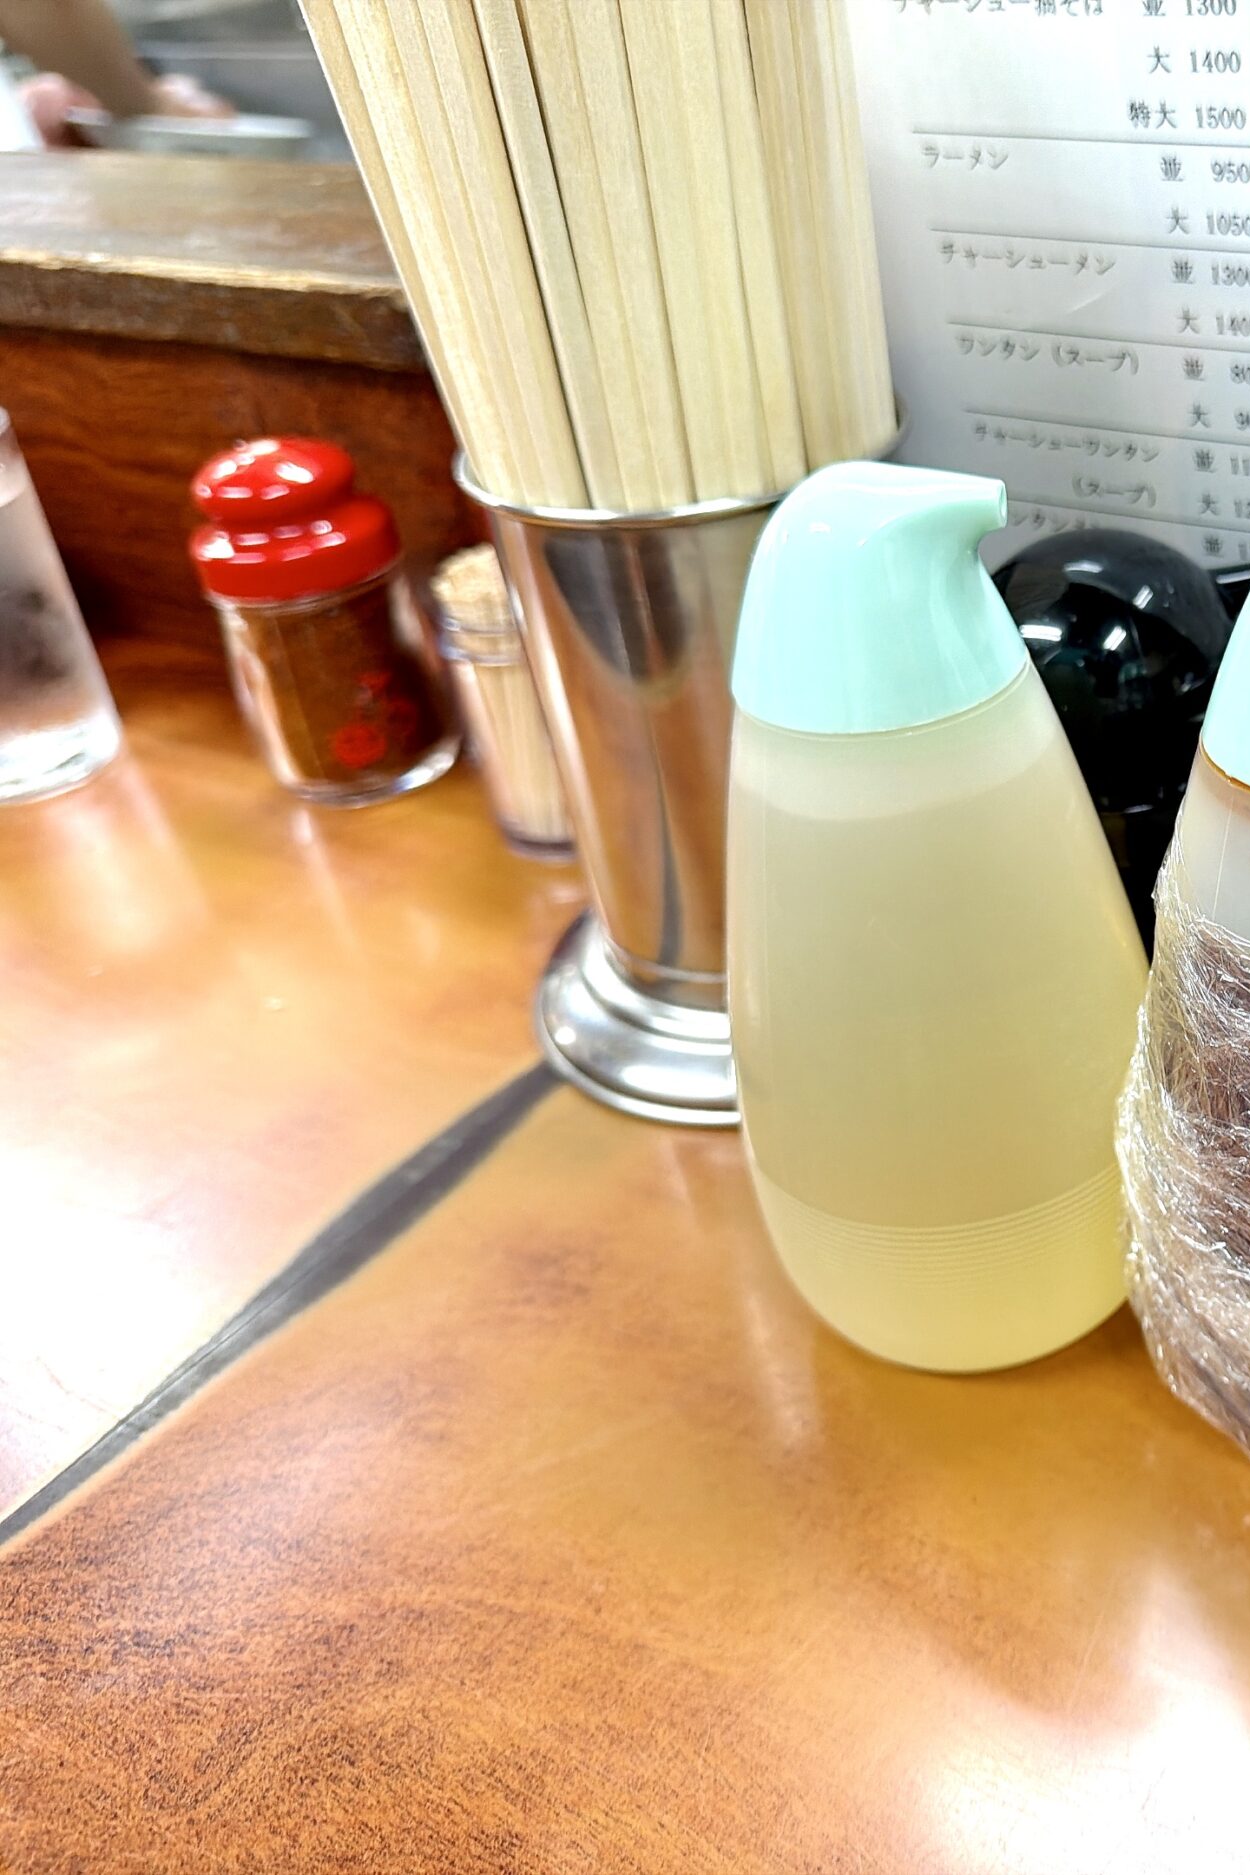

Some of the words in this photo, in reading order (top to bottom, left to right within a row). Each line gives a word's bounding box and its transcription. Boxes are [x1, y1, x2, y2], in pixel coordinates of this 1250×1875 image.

[1148, 46, 1171, 74] 大
[1190, 50, 1241, 74] 1400
[1128, 99, 1177, 130] 特大
[1195, 104, 1247, 130] 1500
[921, 142, 1009, 169] ラーメン
[1160, 153, 1183, 182] 並
[1166, 206, 1189, 235] 大
[939, 242, 1115, 276] チャーシューメン
[1177, 306, 1200, 334] 大
[1189, 402, 1211, 428] 大
